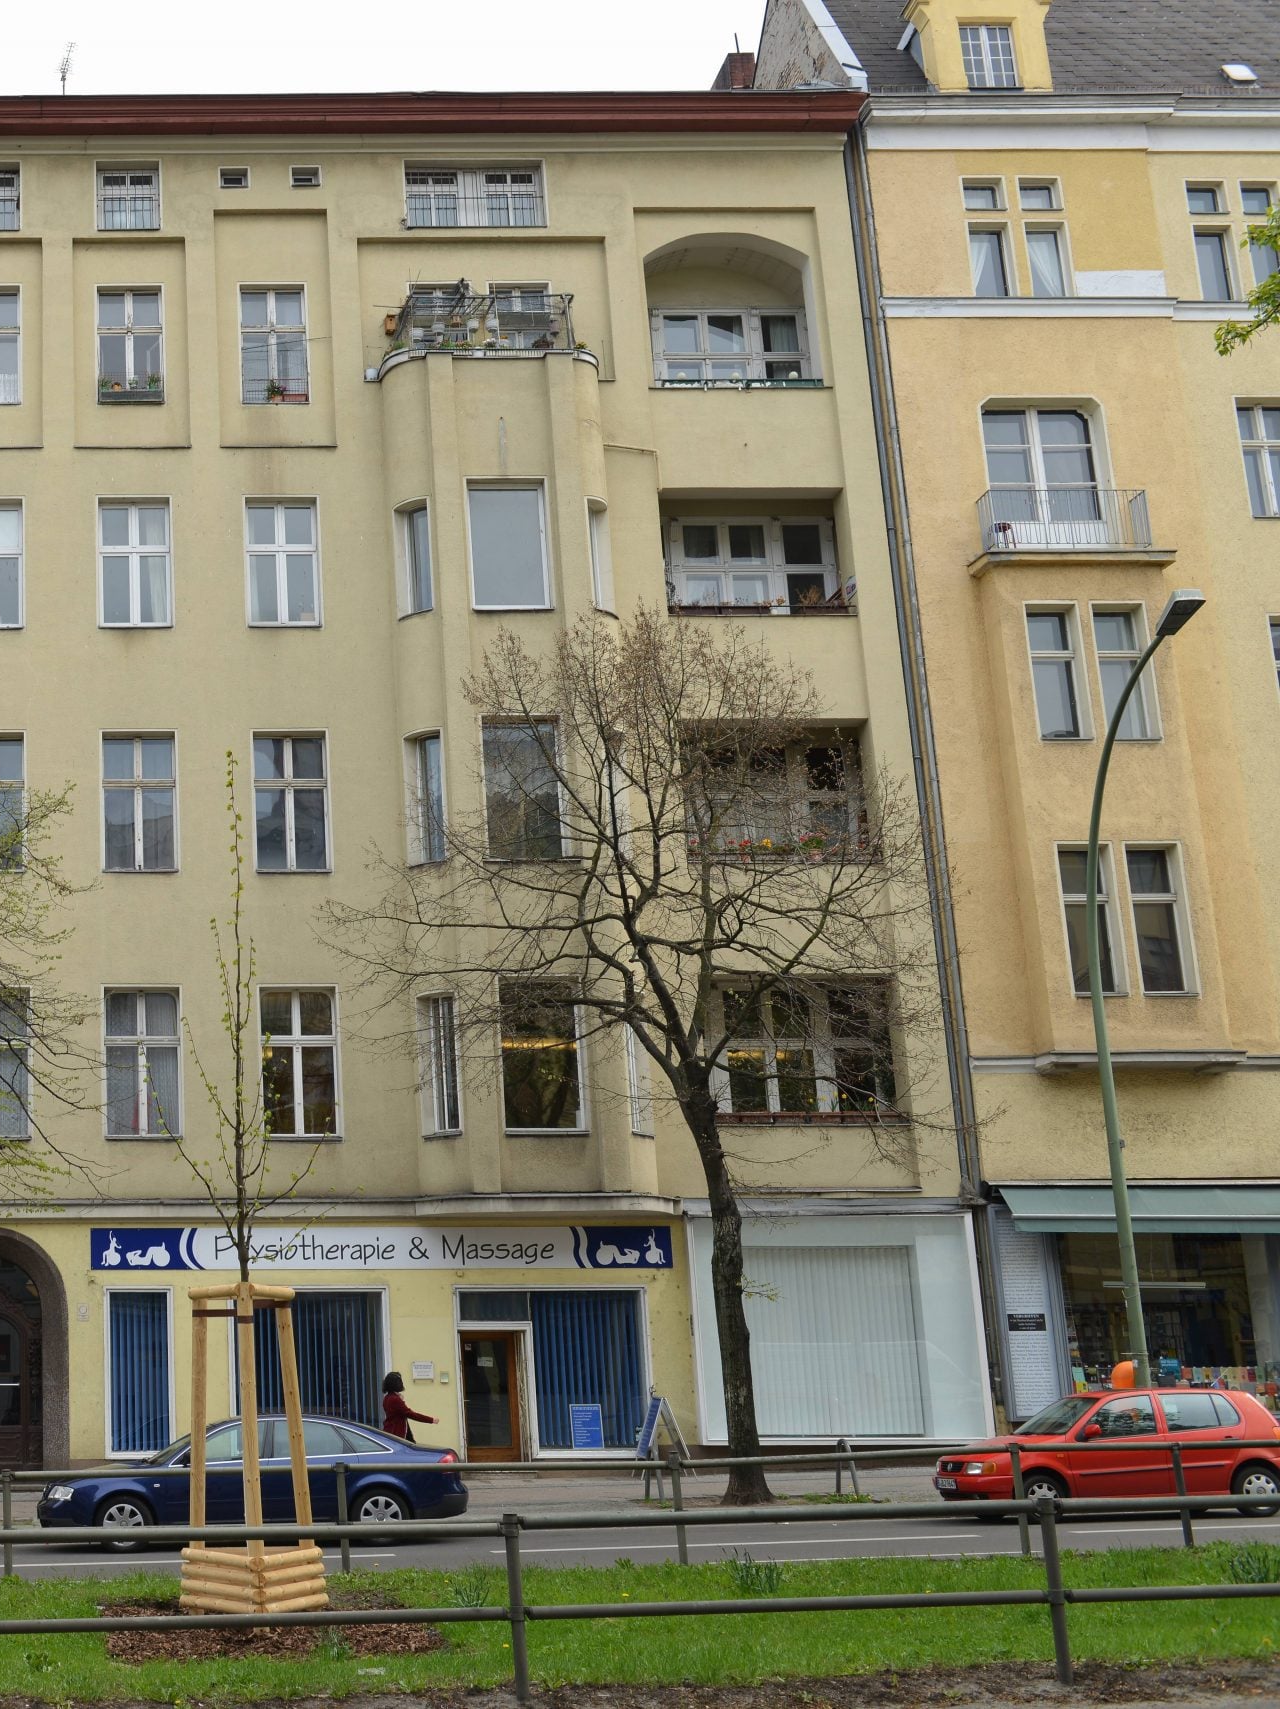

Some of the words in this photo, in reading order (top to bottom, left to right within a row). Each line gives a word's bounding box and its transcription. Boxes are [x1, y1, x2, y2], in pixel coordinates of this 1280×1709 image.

[214, 1234, 395, 1265] Pysiotherapie
[408, 1236, 430, 1260] &
[442, 1234, 555, 1265] Massage
